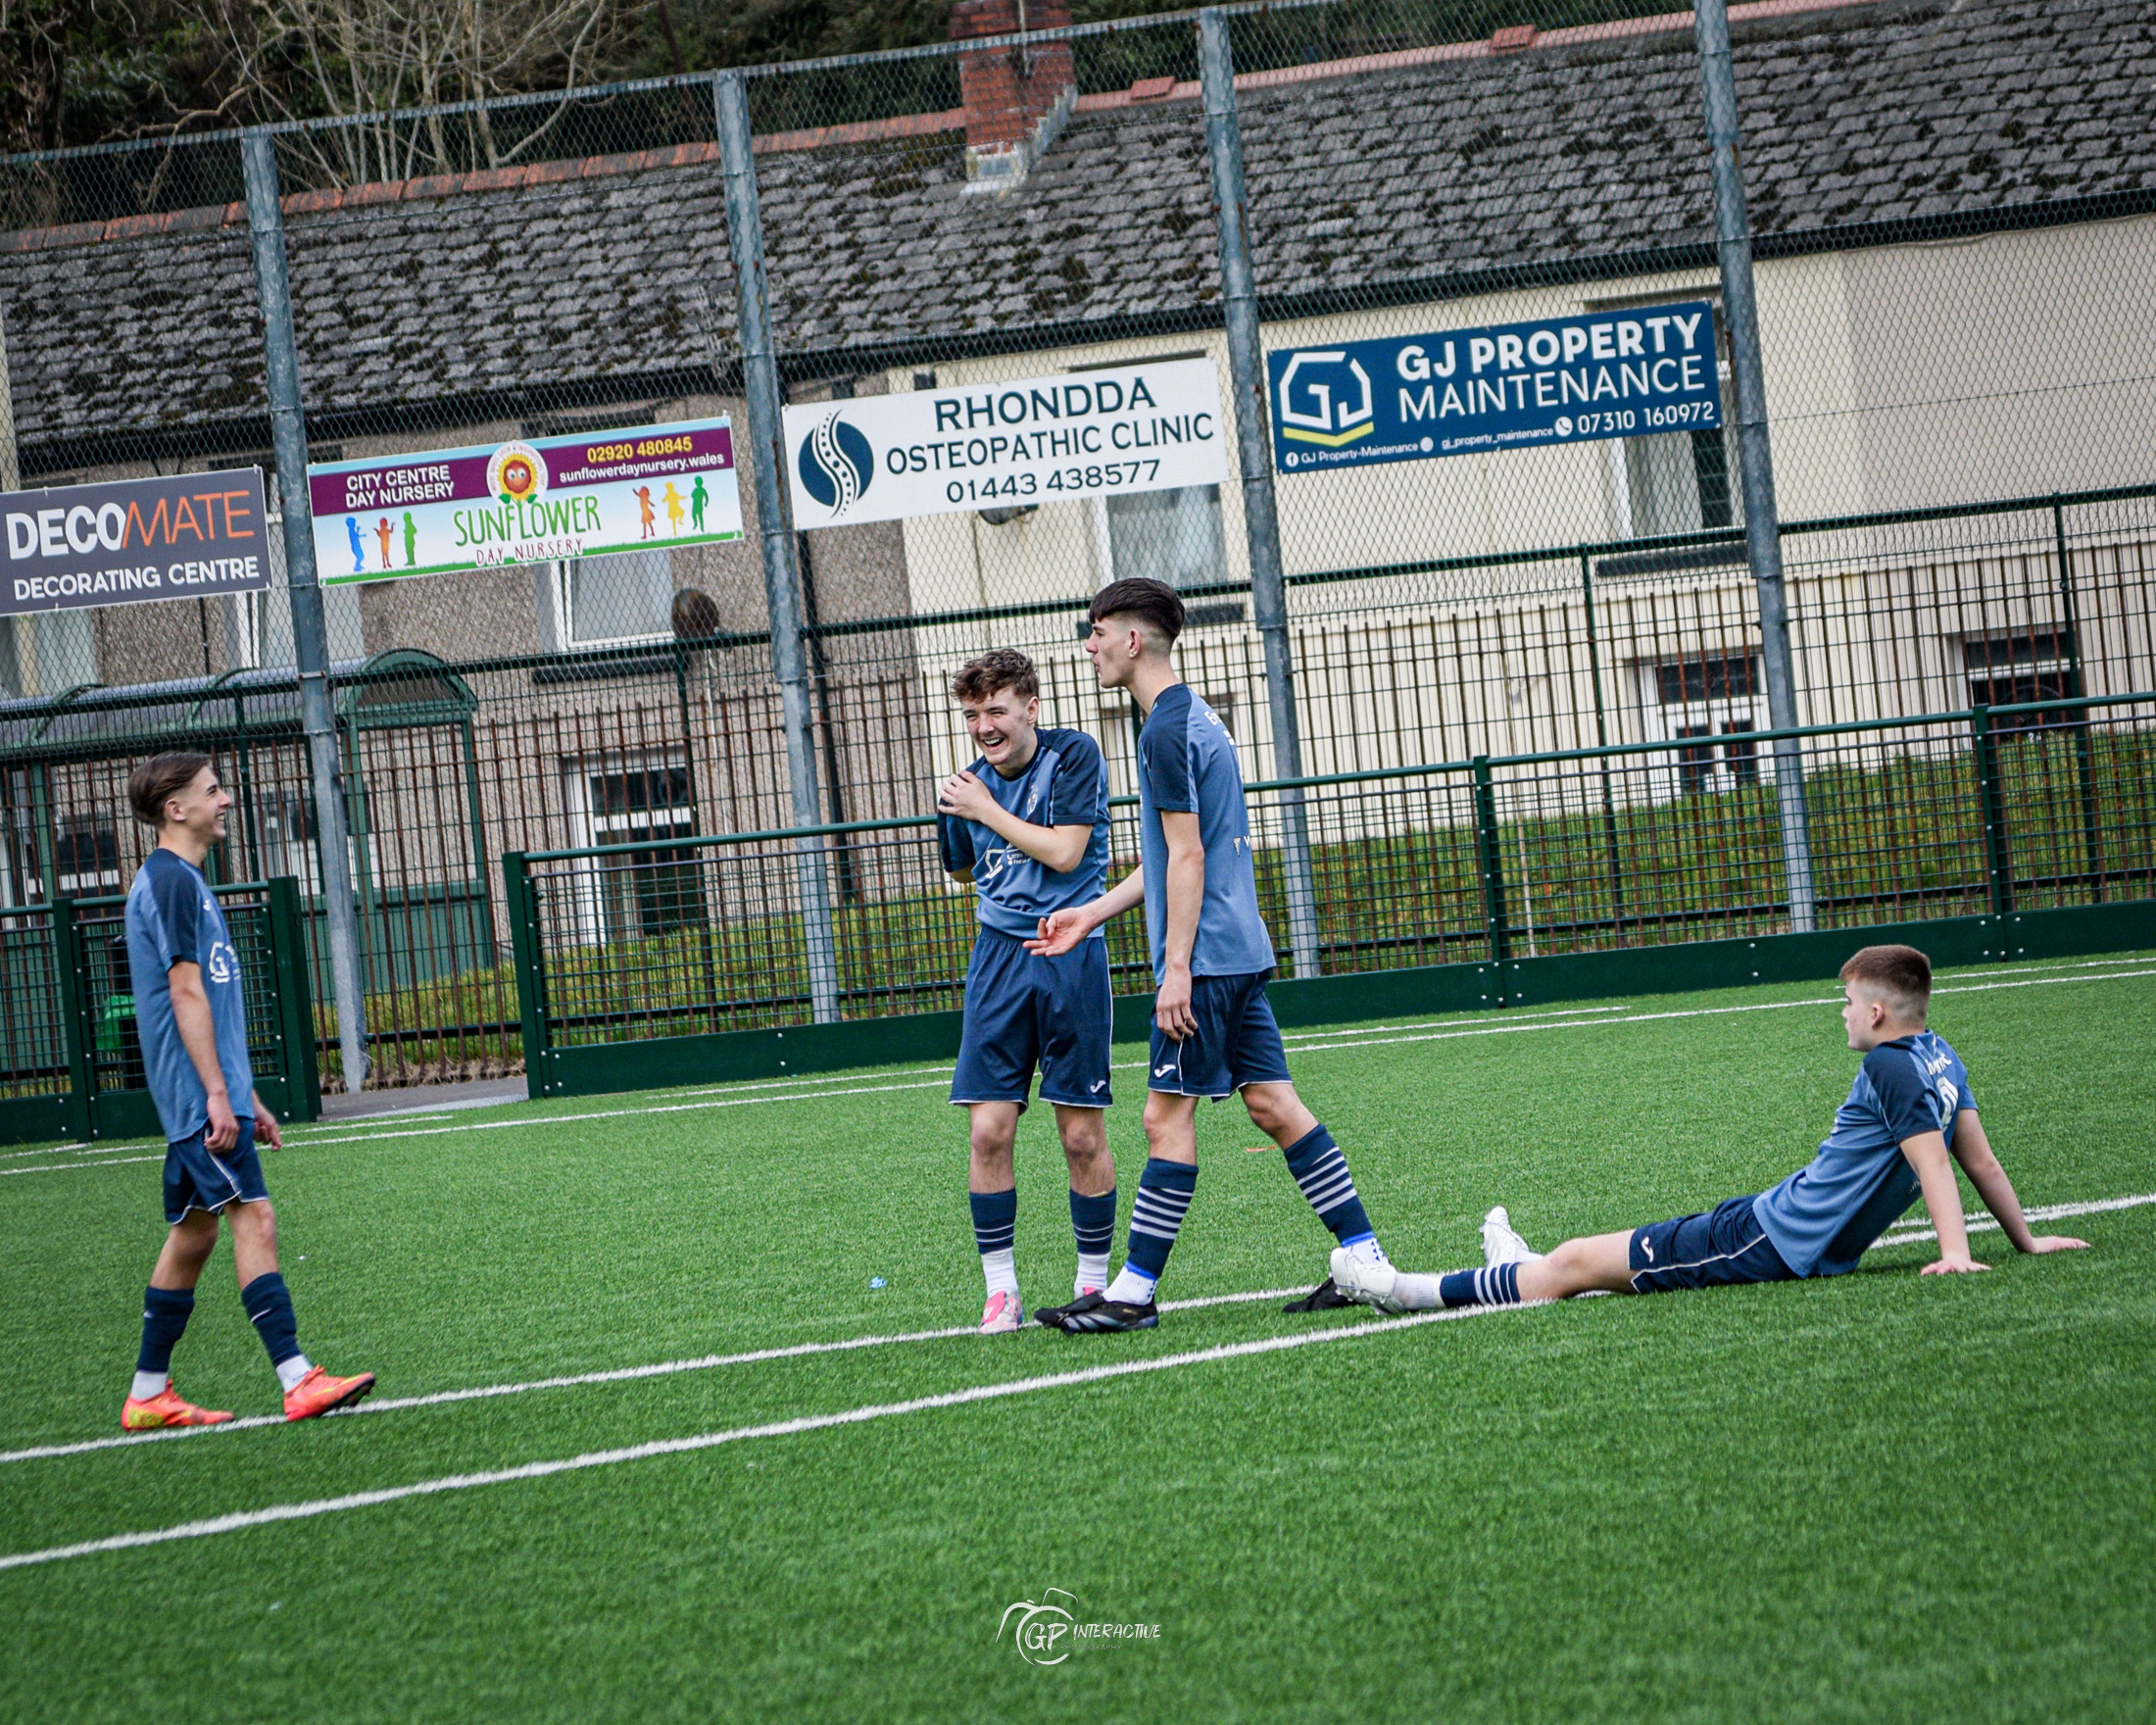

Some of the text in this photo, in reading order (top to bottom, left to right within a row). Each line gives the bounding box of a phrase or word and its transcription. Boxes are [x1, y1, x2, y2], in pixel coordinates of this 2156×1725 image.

[1396, 313, 1702, 382] GJ PROPERTY
[933, 376, 1157, 433] RHONDDA
[1398, 355, 1705, 423] MAINTENANCE
[1577, 401, 1715, 434] 07310 160972
[586, 435, 694, 464] 02920 480845
[886, 413, 1214, 475] OSTEOPATHIC CLINIC
[1300, 443, 1419, 463] GJ Property-Maintenance
[346, 465, 451, 491] CITY CENTRE
[559, 452, 725, 483] sunflowerdaynursery.wales
[947, 459, 1160, 504] 01443 438577
[345, 481, 455, 509] DAY NURSERY
[5, 490, 255, 561] DECOMATE
[453, 495, 602, 547] SUNFLOWER
[476, 538, 582, 565] DAY NURSERY
[13, 556, 260, 601] DECORATING CENTRE
